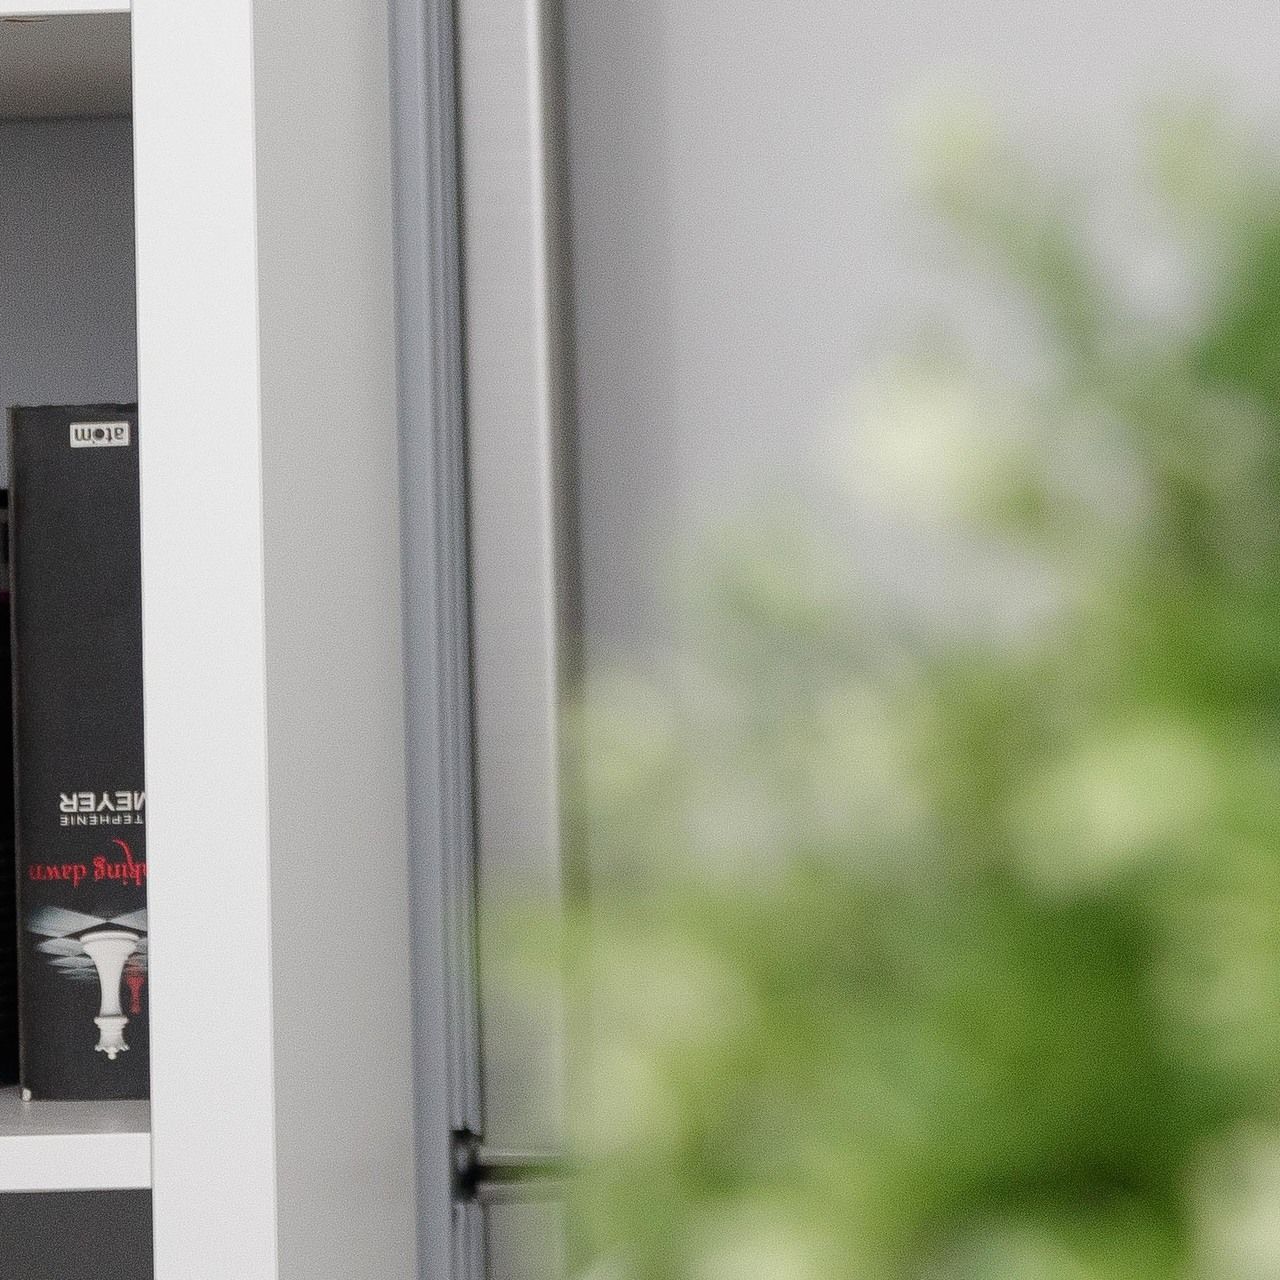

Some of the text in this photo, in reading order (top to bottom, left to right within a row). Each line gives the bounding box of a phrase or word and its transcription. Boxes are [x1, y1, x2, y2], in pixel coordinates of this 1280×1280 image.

[74, 427, 124, 444] atom
[60, 814, 143, 826] TEPHENIE
[27, 864, 88, 888] dawn
